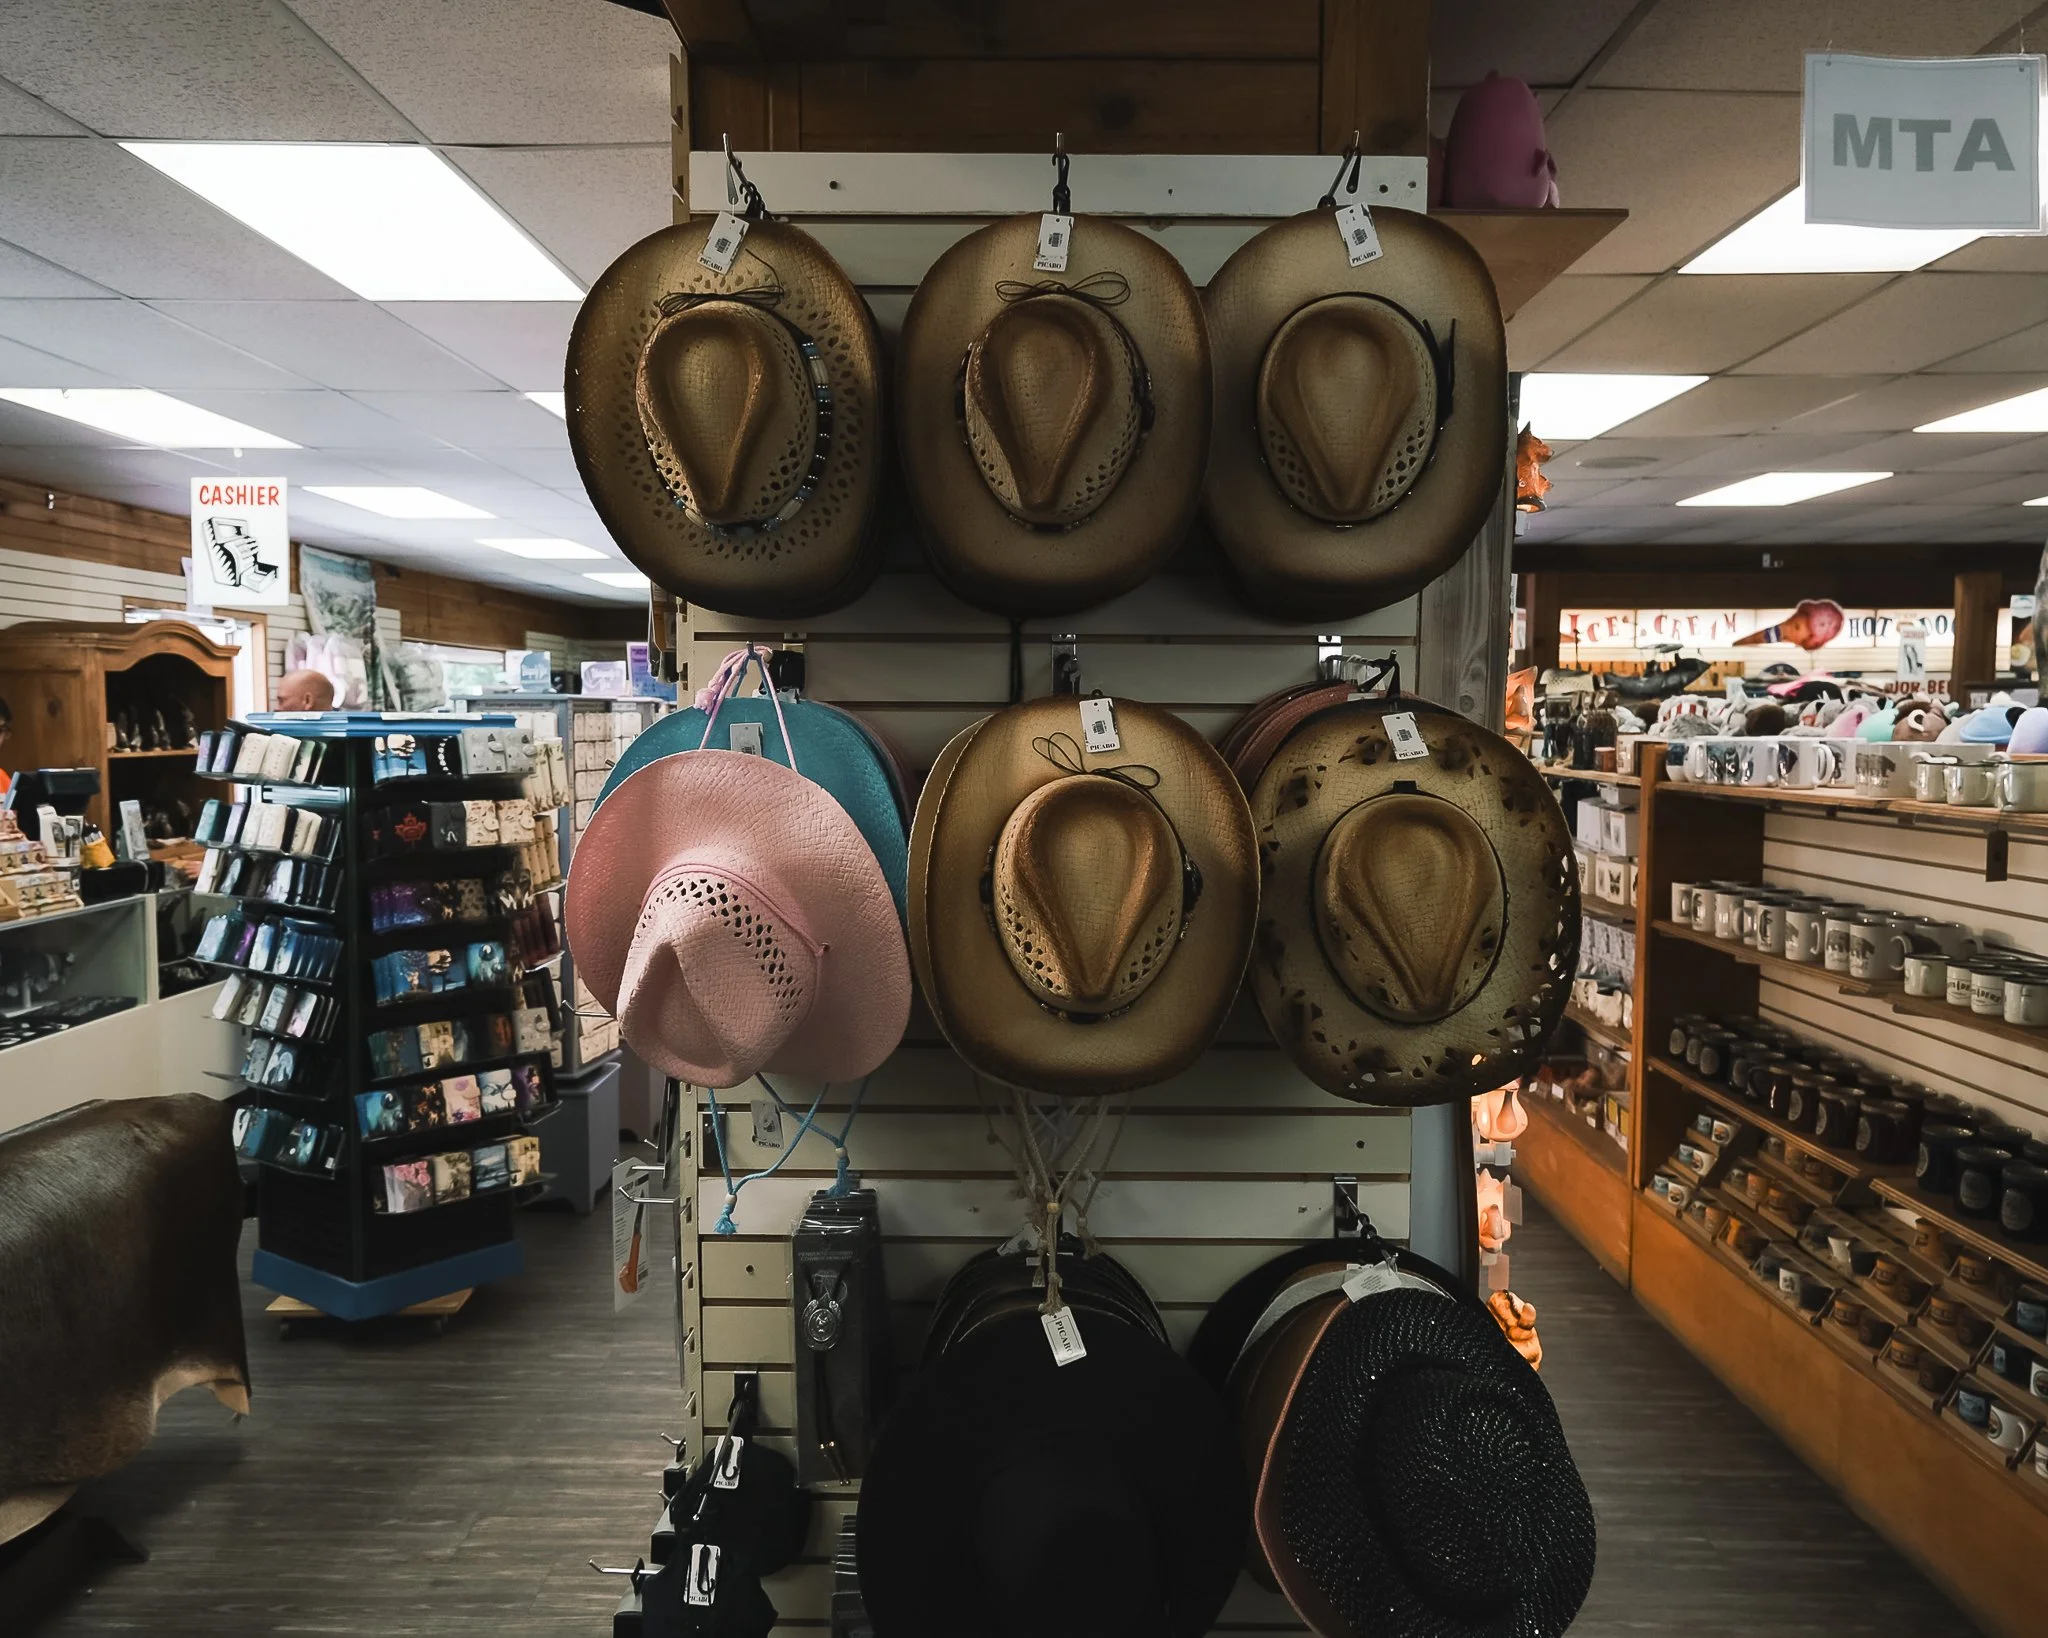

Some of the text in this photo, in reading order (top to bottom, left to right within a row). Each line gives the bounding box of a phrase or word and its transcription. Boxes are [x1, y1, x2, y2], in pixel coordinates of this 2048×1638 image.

[199, 485, 280, 506] CASHIER
[1568, 613, 1619, 643] ICE
[1849, 615, 1893, 639] HOT
[1919, 614, 1955, 637] DO
